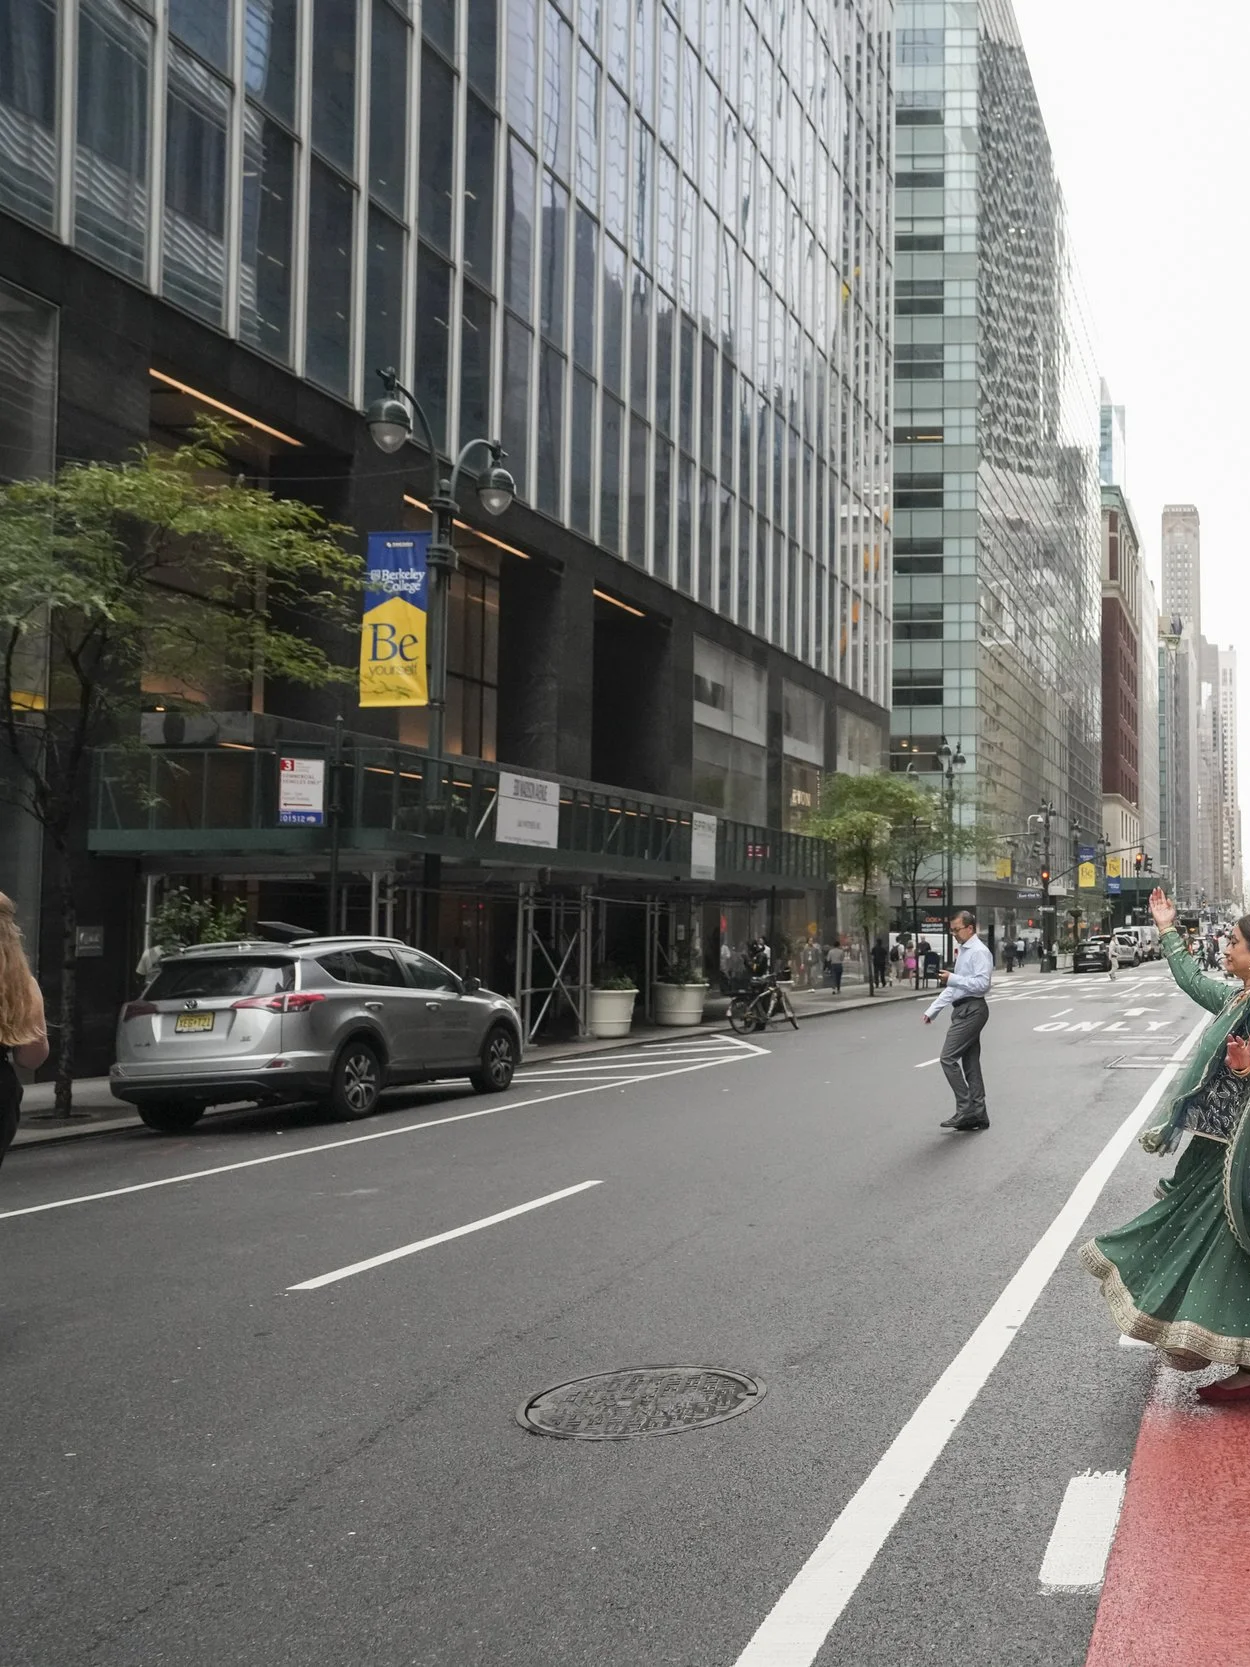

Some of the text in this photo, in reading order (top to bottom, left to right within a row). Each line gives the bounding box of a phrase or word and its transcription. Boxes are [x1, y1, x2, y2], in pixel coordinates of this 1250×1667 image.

[381, 567, 426, 583] Berkeley
[383, 579, 422, 594] College
[367, 622, 419, 662] Be
[368, 662, 418, 677] yourself
[284, 760, 292, 770] 3
[1033, 1021, 1173, 1032] ONLY
